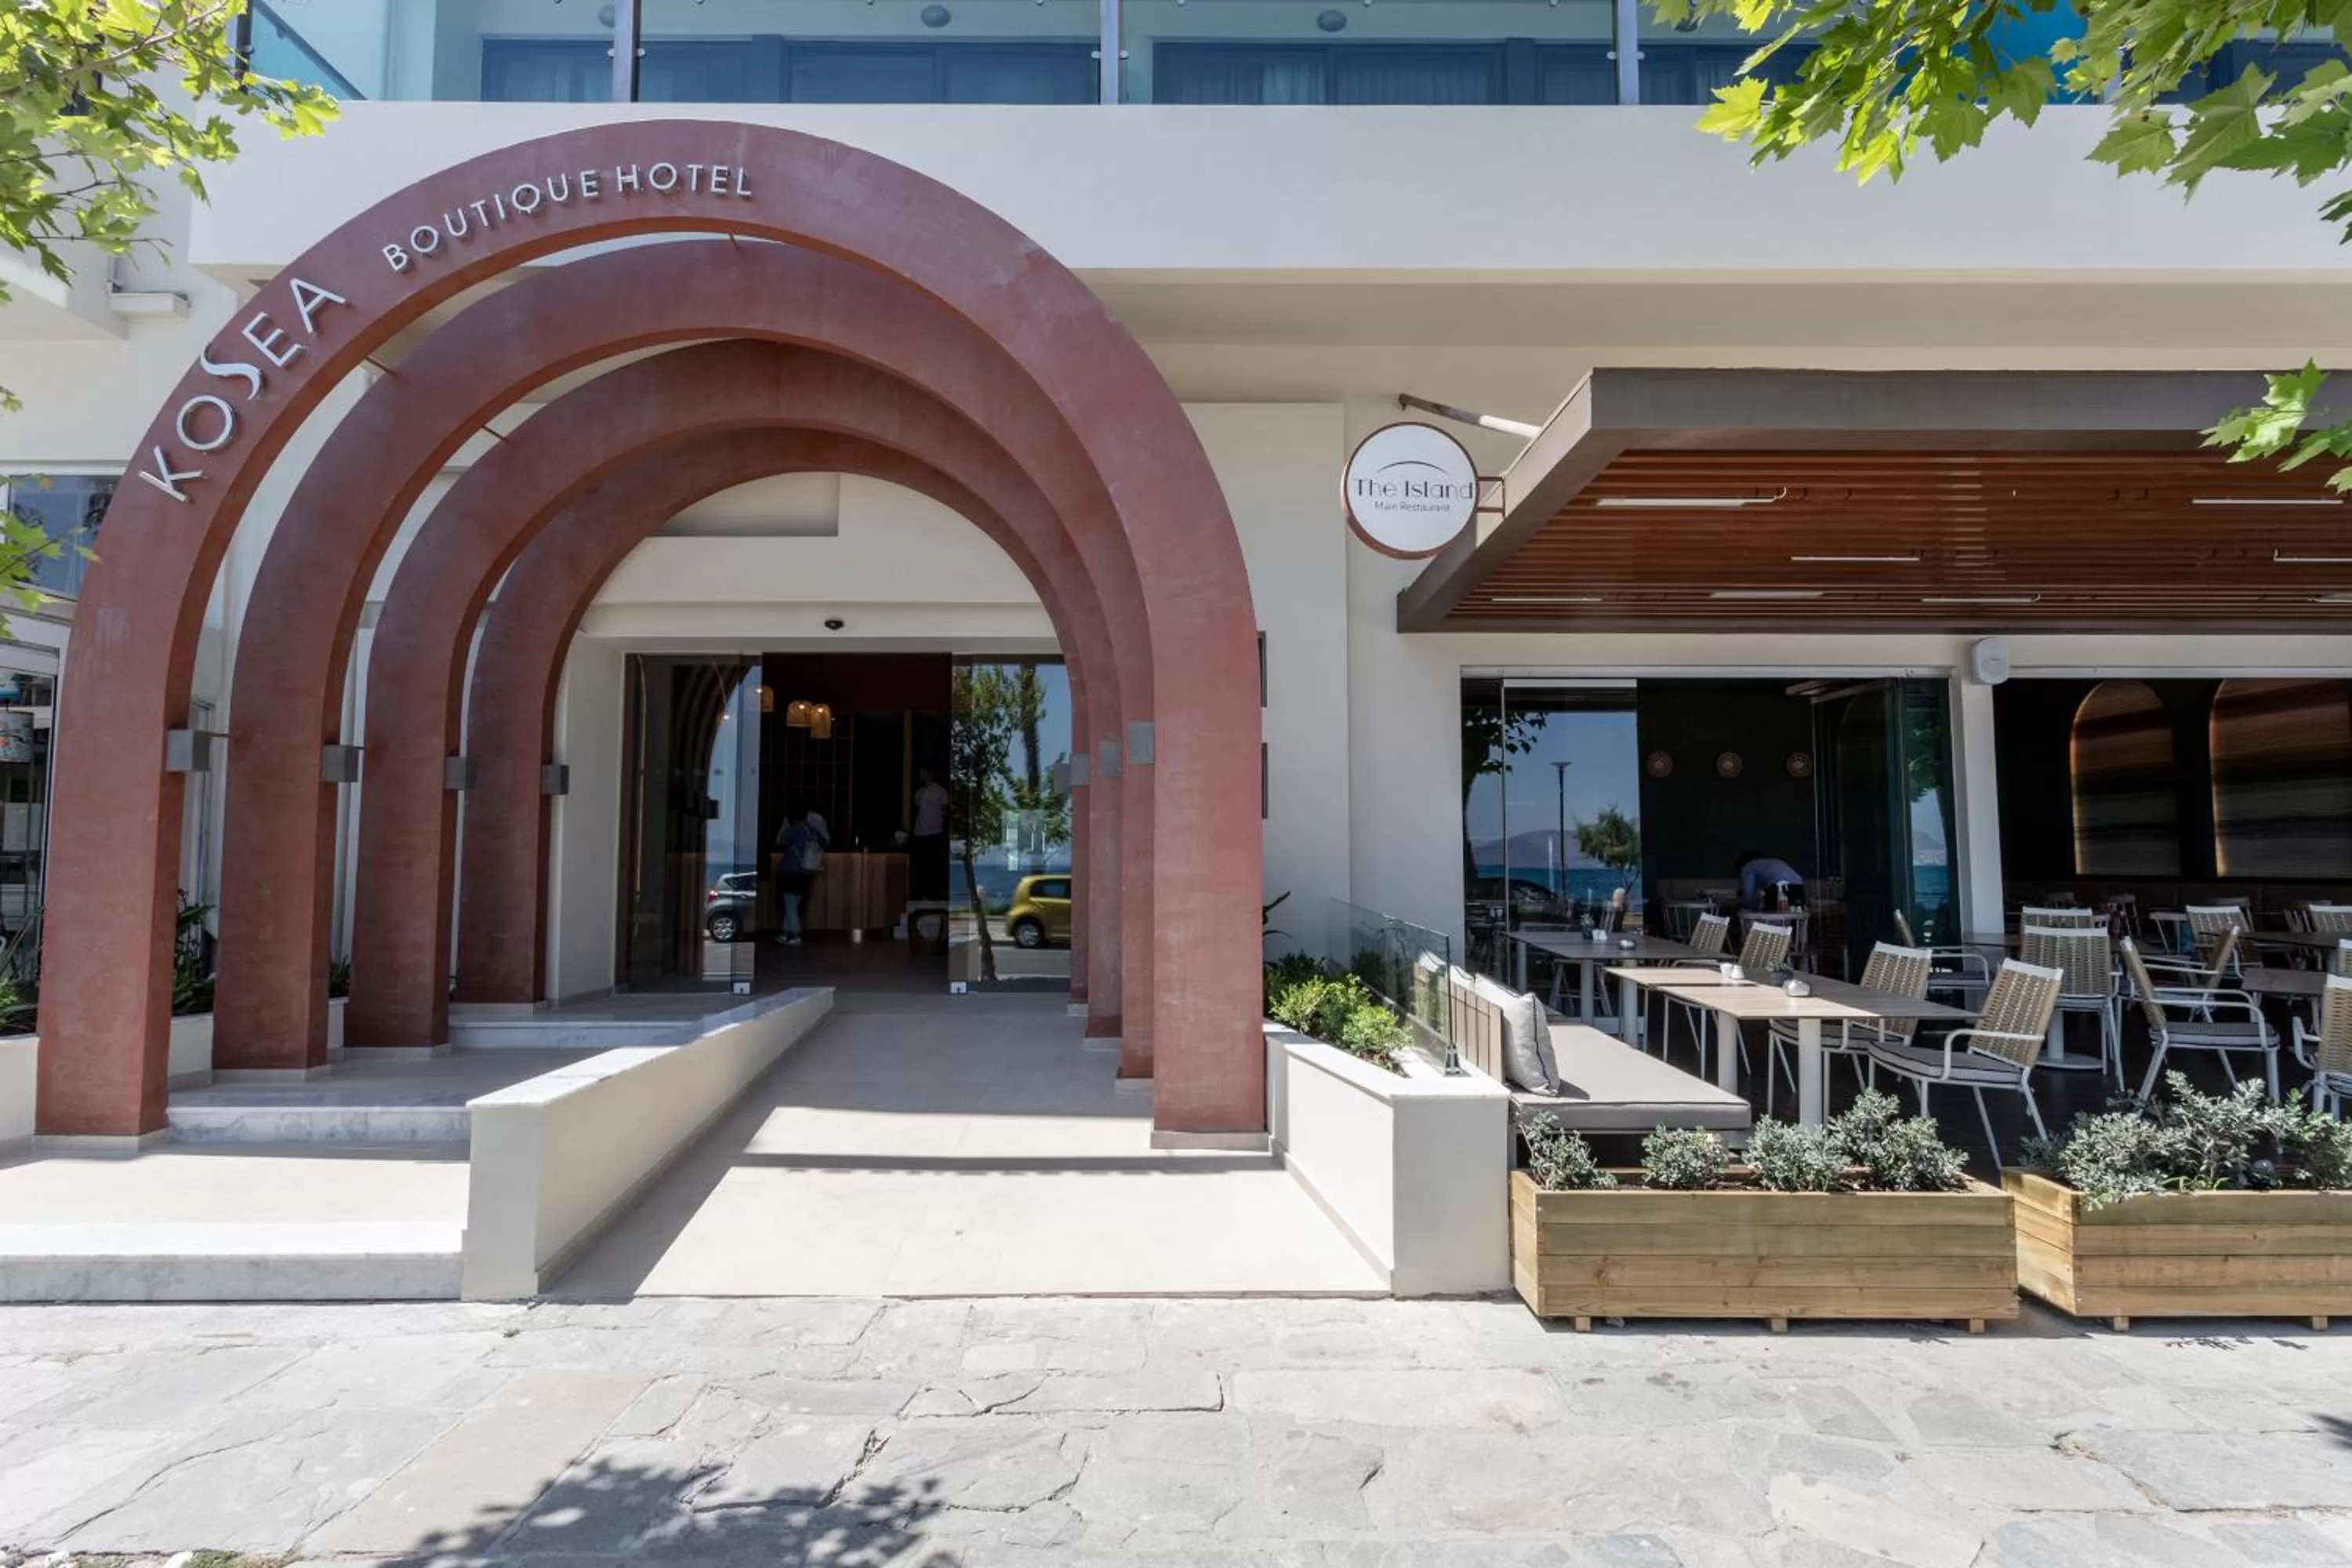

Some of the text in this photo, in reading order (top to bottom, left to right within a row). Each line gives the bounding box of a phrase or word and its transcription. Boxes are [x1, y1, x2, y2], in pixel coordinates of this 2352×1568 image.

[138, 162, 753, 503] KOSEA BOUTIQUE HOTEL
[1355, 479, 1473, 499] The Island
[1375, 502, 1450, 512] Main Restaurant
